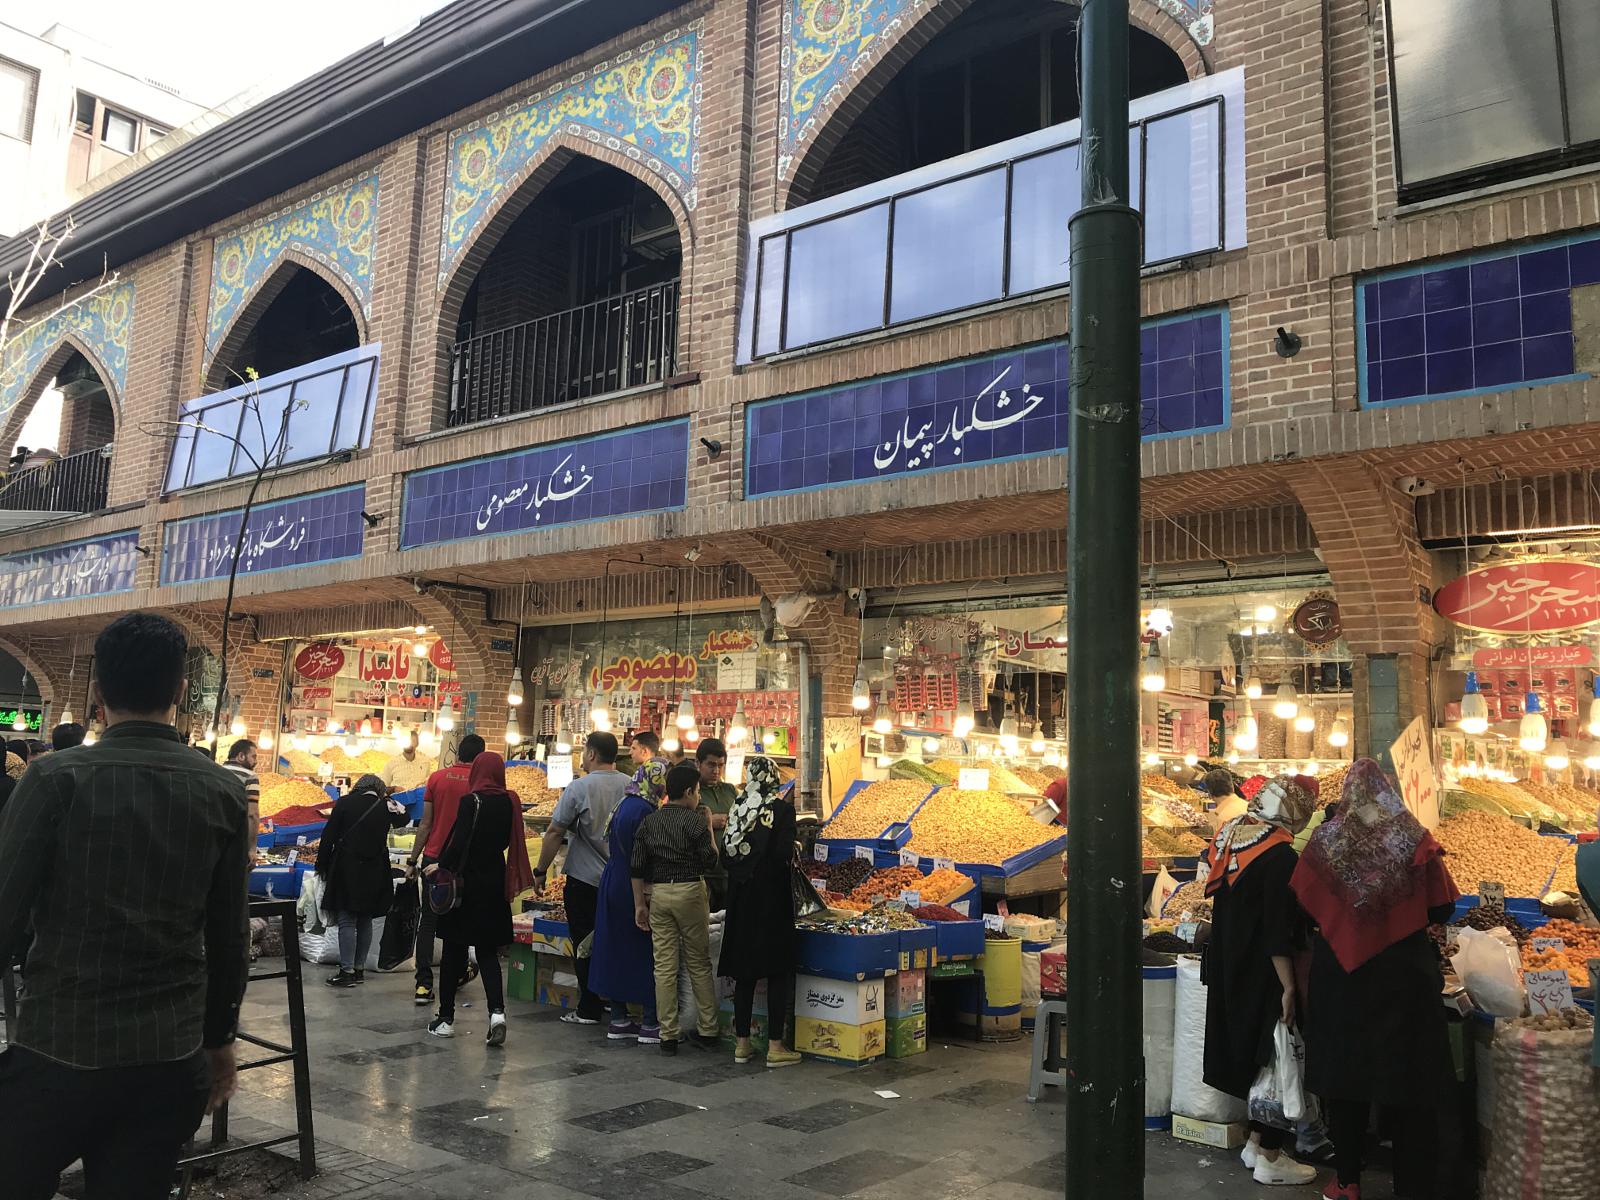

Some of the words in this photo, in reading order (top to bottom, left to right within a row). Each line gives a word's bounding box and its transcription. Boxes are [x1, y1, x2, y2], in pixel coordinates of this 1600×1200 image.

[937, 366, 1044, 456] خشکبار
[873, 415, 933, 470] پیمان
[525, 453, 594, 521] خشکبار
[476, 482, 529, 531] معصومی
[208, 535, 231, 571] خرداد
[230, 528, 253, 571] پانزه
[253, 515, 305, 557] فروشگاه
[1543, 606, 1589, 620] ۱۳۱۱
[300, 645, 339, 676] سحرخیز
[700, 628, 754, 660] خشکبار
[1484, 650, 1516, 666] ایرانی
[1519, 649, 1556, 663] زعفران
[1557, 647, 1580, 662] عیار
[590, 652, 698, 692] معصومی
